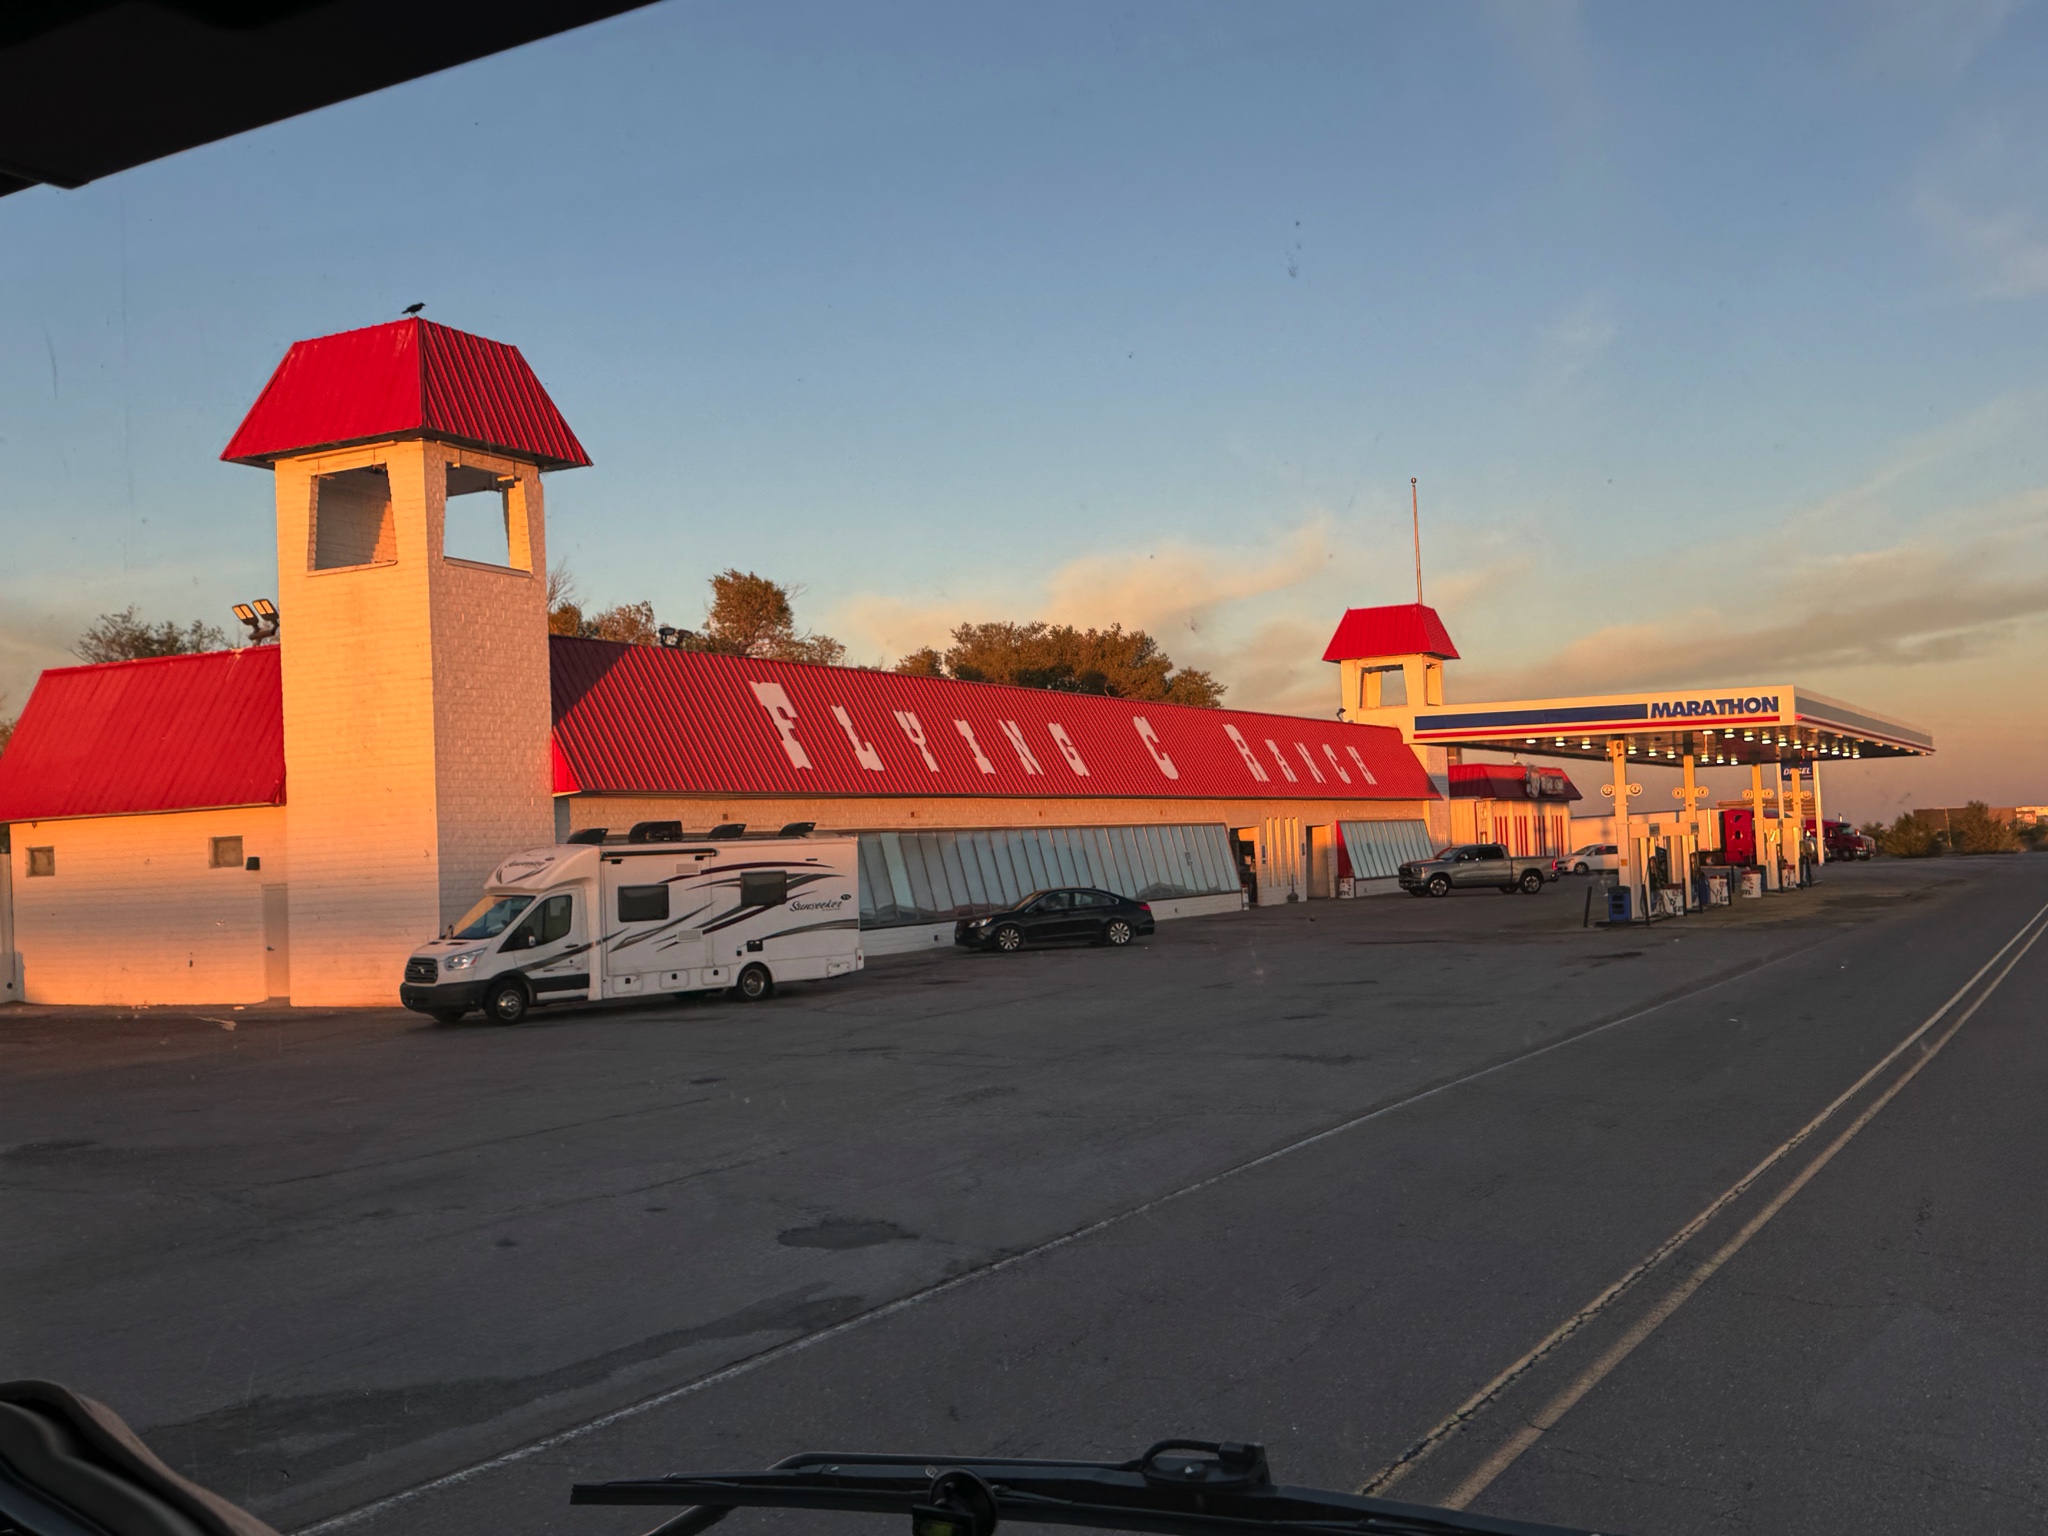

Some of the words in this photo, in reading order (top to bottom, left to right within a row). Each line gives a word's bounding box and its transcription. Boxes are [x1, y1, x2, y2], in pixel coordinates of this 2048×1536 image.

[1650, 696, 1779, 719] MARATHON
[750, 680, 1090, 777] FLYING
[1132, 715, 1179, 781] C
[1222, 723, 1378, 785] RANCH
[1783, 767, 1811, 776] DSEL
[789, 899, 842, 912] Sunseeker
